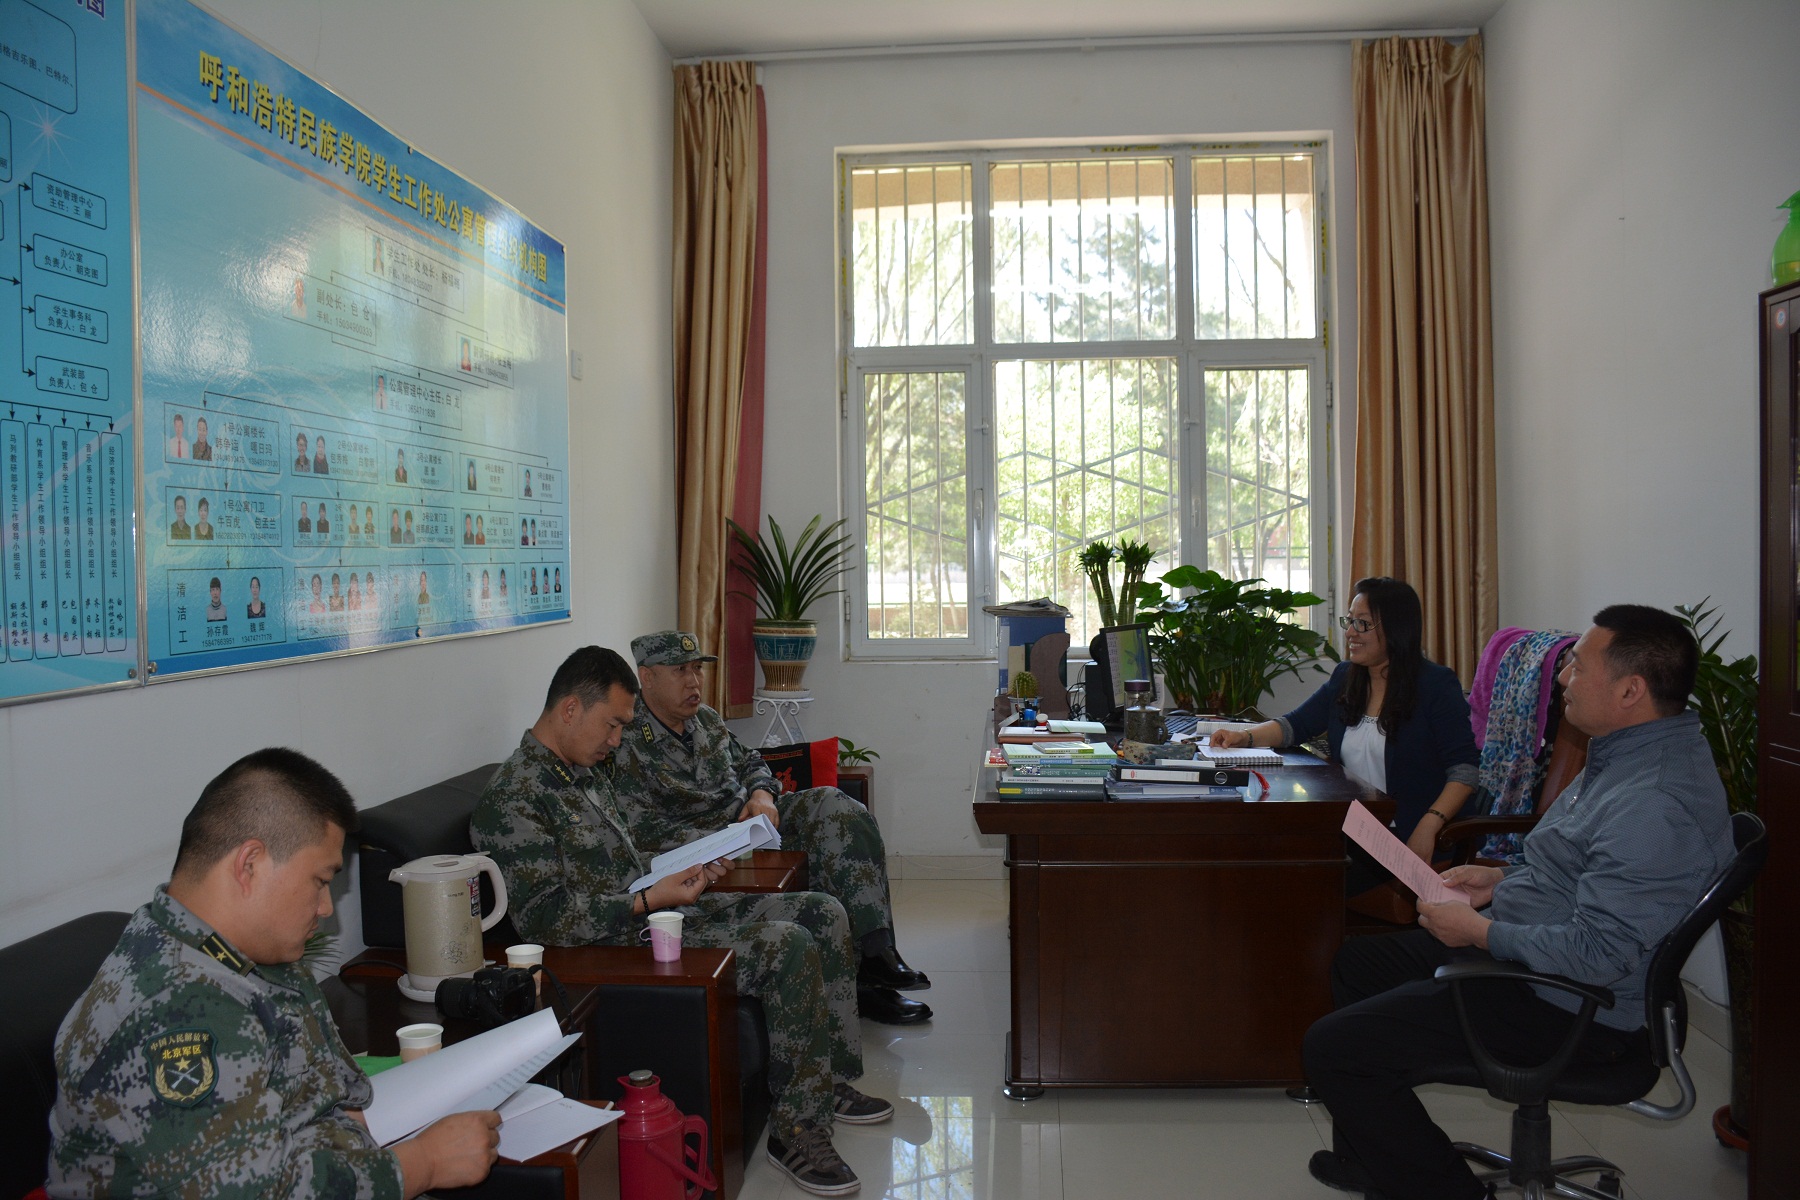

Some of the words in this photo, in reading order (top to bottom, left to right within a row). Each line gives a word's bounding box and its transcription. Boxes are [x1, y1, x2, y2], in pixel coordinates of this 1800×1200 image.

[47, 184, 93, 208] 资助管理中心
[60, 248, 83, 263] 办公室
[53, 305, 92, 323] 学生事务科
[62, 367, 85, 380] 武装部
[223, 499, 265, 513] 1号公寓门卫
[177, 582, 188, 643] 清洁工
[150, 1032, 210, 1051] 中国人民解放军
[162, 1044, 202, 1060] 北京军区
